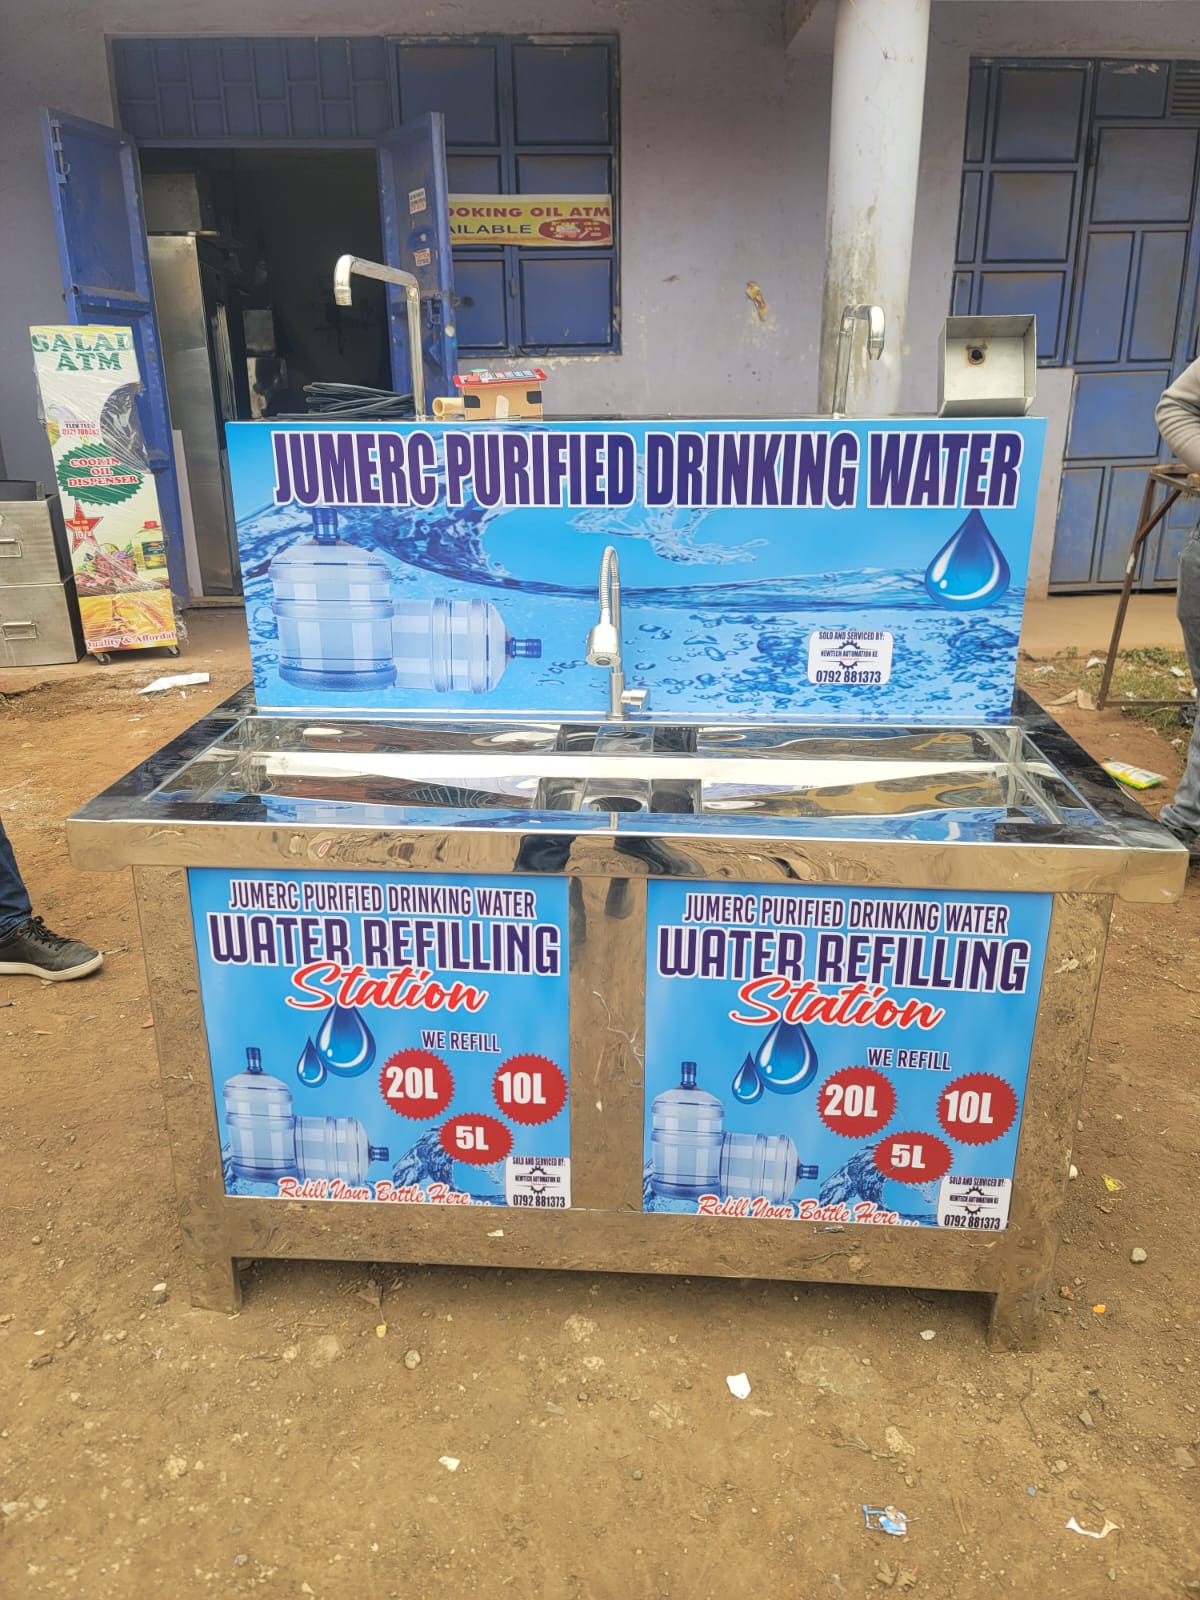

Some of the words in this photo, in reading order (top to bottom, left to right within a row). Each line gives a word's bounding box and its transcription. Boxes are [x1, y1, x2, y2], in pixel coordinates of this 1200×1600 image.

[530, 207, 563, 218] OIL
[569, 207, 610, 217] ATM
[56, 352, 122, 371] ATM
[68, 476, 138, 487] DISPENSER
[91, 467, 113, 476] OIL
[271, 430, 438, 507] JUMERC
[443, 431, 638, 508] PURIFIED
[644, 430, 859, 509] DRINKING
[867, 431, 1024, 509] WATER
[123, 636, 132, 644] &
[818, 631, 834, 640] SOLD
[834, 632, 846, 640] AND
[847, 632, 875, 640] SERVICED
[816, 670, 842, 682] 0792
[843, 670, 881, 683] 881373
[230, 880, 300, 910] JUMERC
[303, 883, 383, 913] PURIFIED
[388, 885, 472, 917] DRINKING
[477, 888, 537, 919] WATER
[683, 894, 756, 924] JUMERC
[761, 897, 845, 928] PURIFIED
[850, 900, 940, 932] DRINKING
[945, 903, 1009, 935] WATER
[208, 913, 351, 966] WATER
[362, 918, 562, 975] REFILLING
[658, 926, 803, 982] WATER
[817, 933, 1031, 992] REFILLING
[286, 961, 488, 1011] Station
[730, 976, 944, 1029] Station
[421, 1030, 447, 1050] WE
[450, 1031, 501, 1053] REFILL
[868, 1048, 893, 1067] WE
[897, 1049, 951, 1070] REFILL
[386, 1065, 439, 1100] 20L
[498, 1071, 547, 1105] 10L
[823, 1083, 879, 1118] 20L
[944, 1090, 994, 1124] 10L
[455, 1125, 489, 1151] 5L
[525, 1157, 534, 1165] AND
[535, 1157, 557, 1166] SERVICED
[890, 1143, 926, 1169] 5L
[279, 1177, 328, 1199] Refill
[329, 1179, 370, 1201] Your
[374, 1181, 424, 1203] Bottle
[962, 1176, 972, 1185] AND
[973, 1177, 997, 1187] SERVICED
[513, 1194, 533, 1206] 0792
[535, 1195, 566, 1208] 881373
[698, 1195, 749, 1217] Refill
[750, 1197, 793, 1219] Your
[799, 1199, 850, 1222] Bottle
[944, 1214, 967, 1227] 0792
[967, 1215, 1001, 1230] 881373
